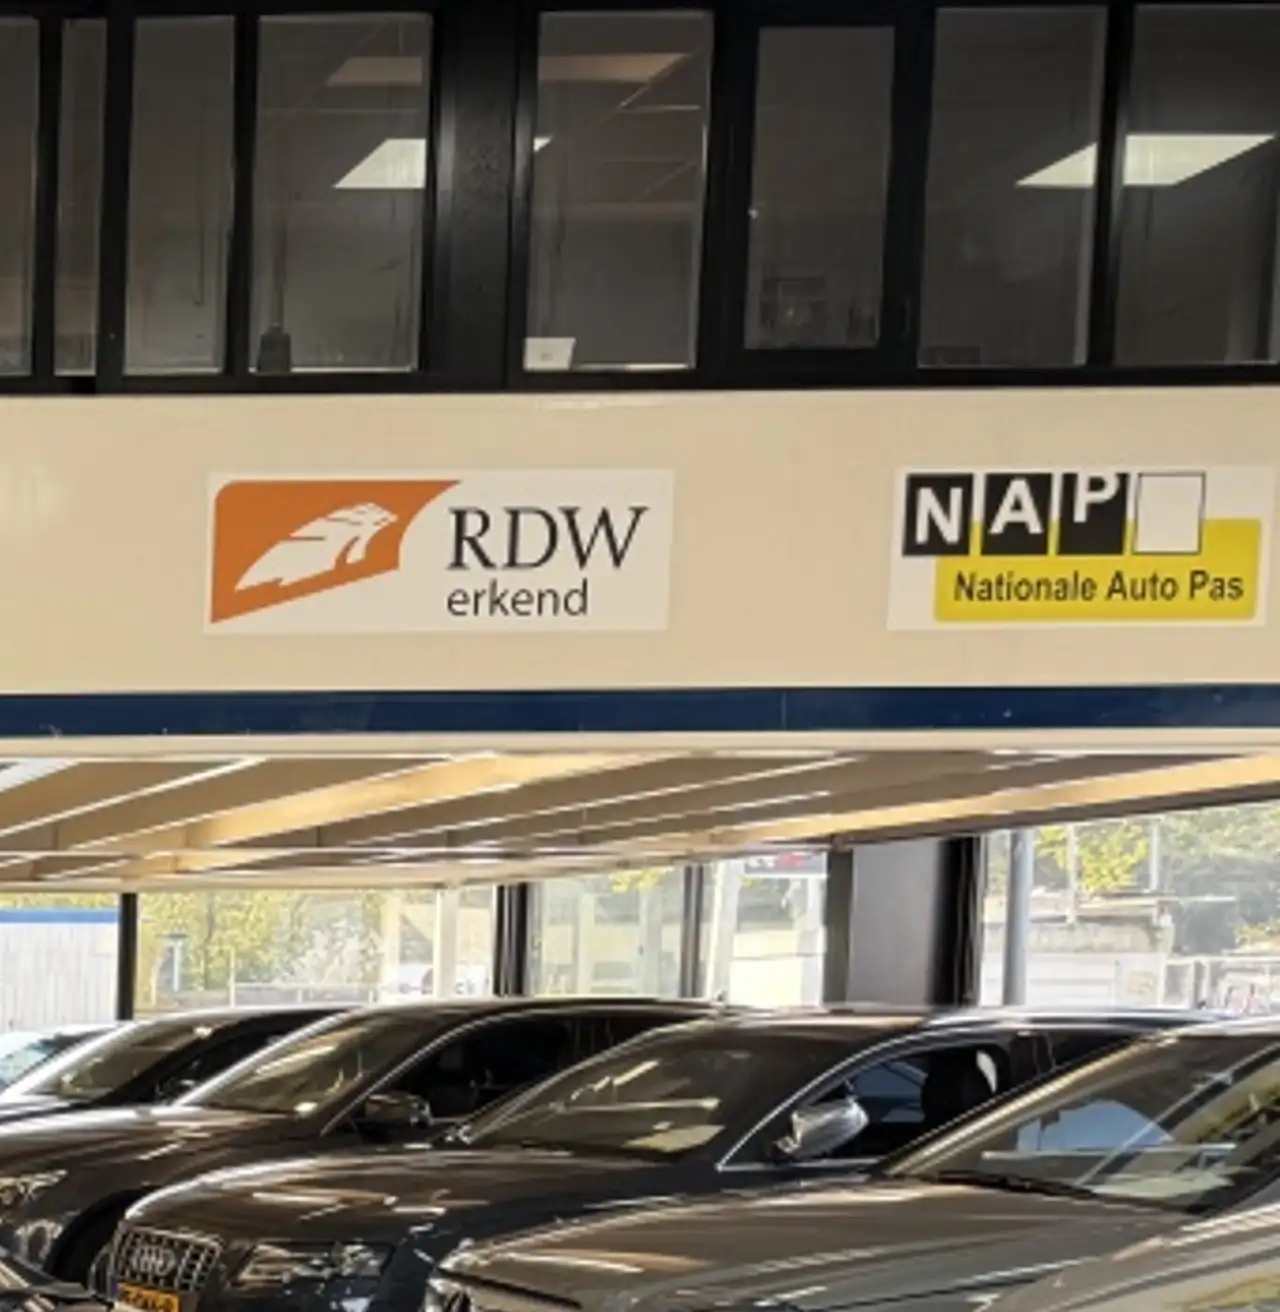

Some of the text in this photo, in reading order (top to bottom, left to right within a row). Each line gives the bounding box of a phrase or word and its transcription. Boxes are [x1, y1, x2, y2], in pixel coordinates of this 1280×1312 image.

[915, 471, 1119, 544] NAP
[446, 505, 650, 571] RDW
[446, 577, 589, 617] erkend
[953, 568, 1245, 602] Nationale Auto Pas
